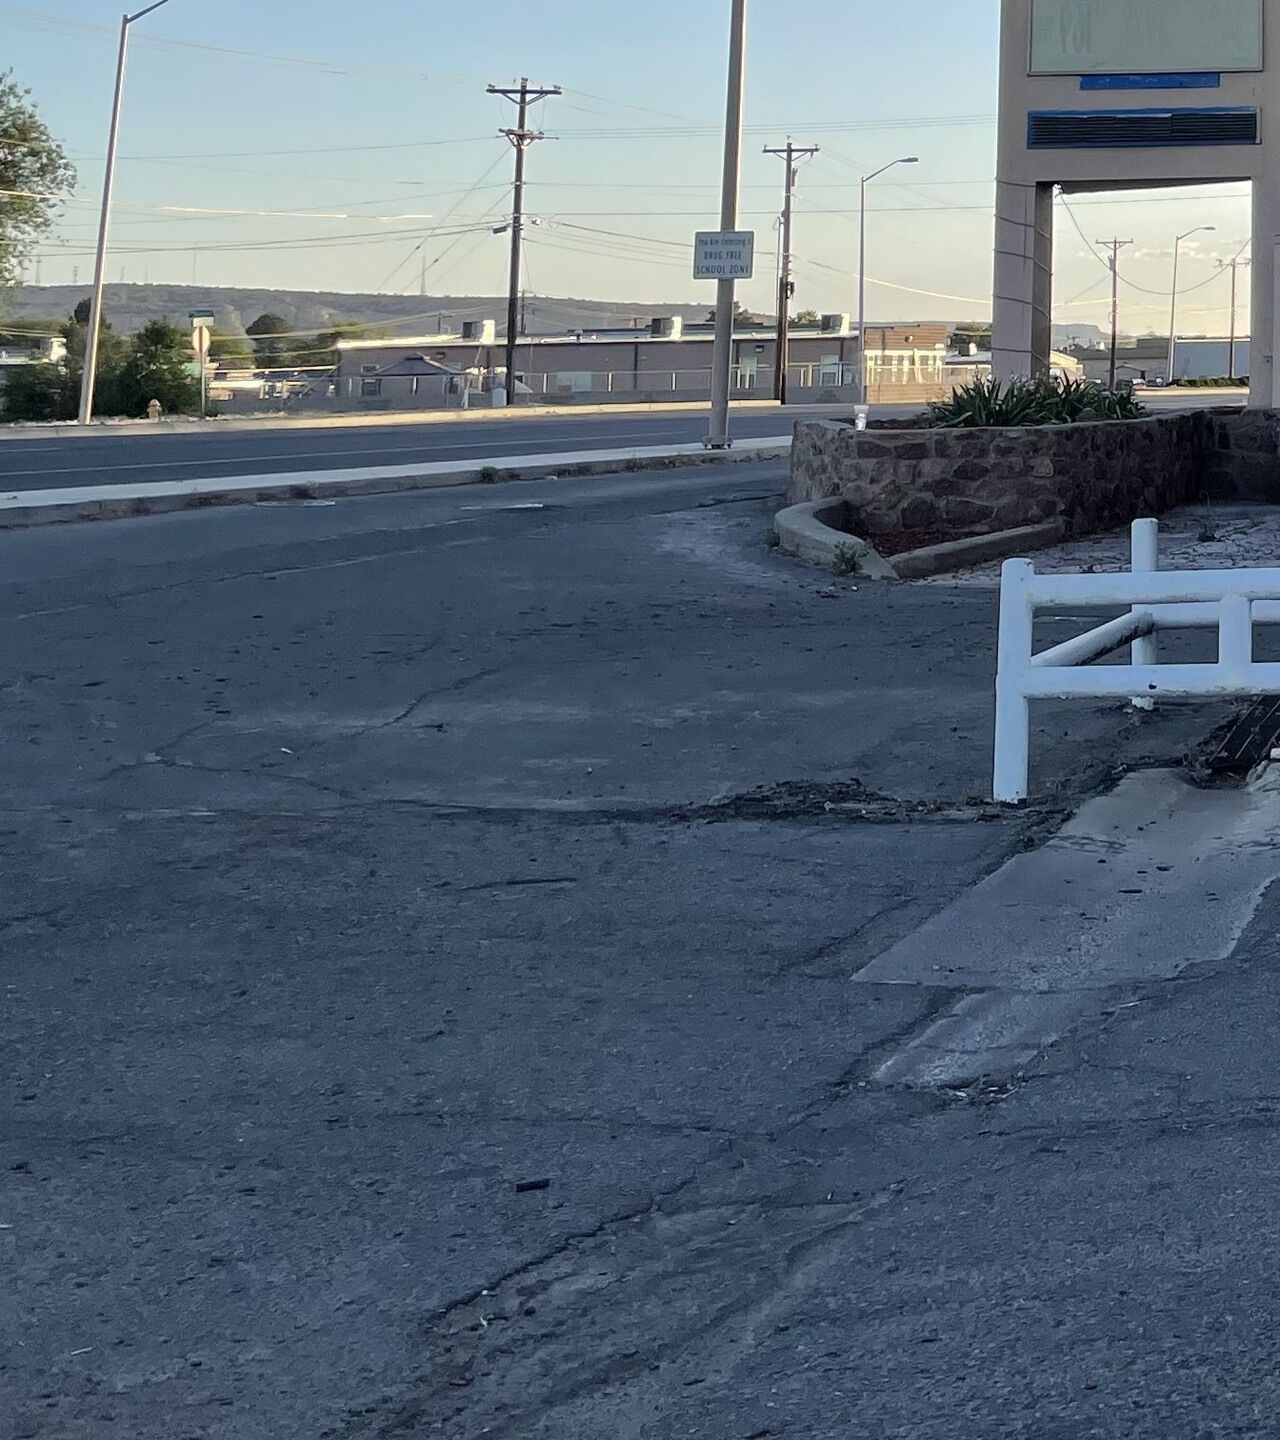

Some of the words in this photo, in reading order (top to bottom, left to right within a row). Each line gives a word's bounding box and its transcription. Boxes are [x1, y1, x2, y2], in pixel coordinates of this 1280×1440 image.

[704, 250, 723, 260] DRUG
[726, 250, 742, 260] FREE
[696, 264, 726, 275] SCHOOL
[729, 264, 749, 274] ZONE
